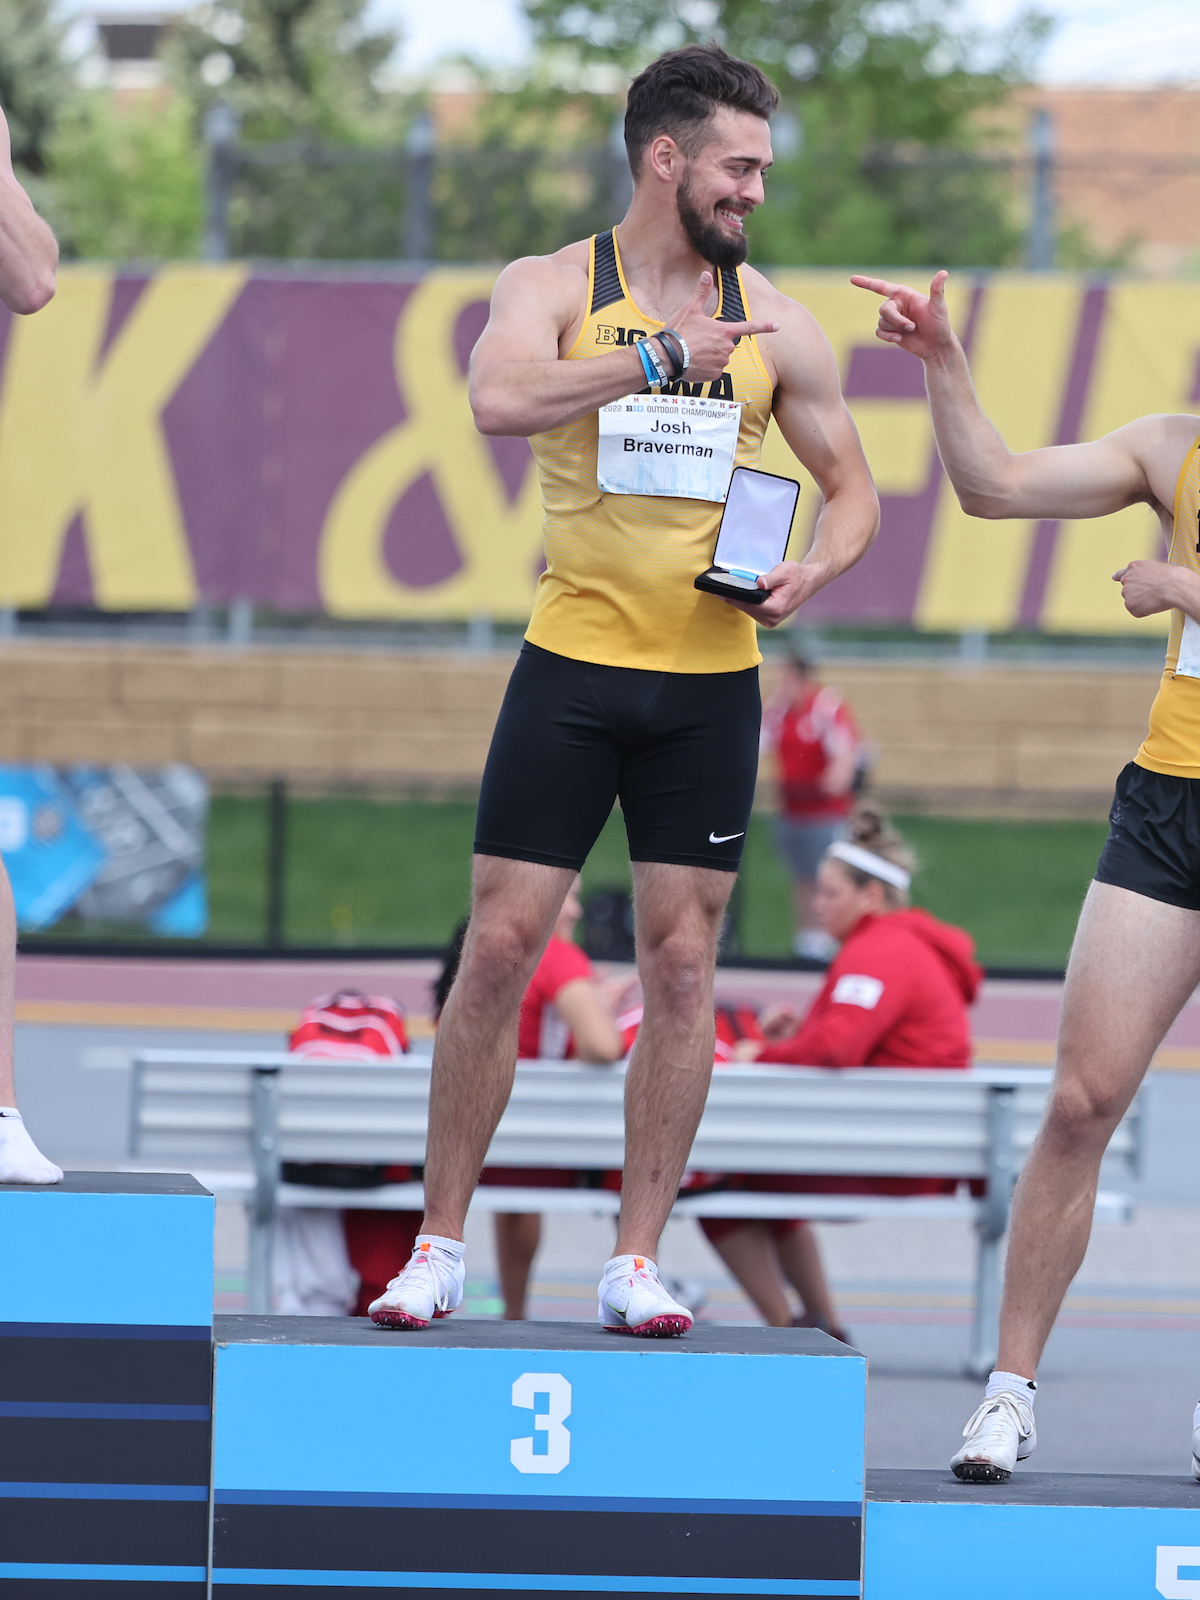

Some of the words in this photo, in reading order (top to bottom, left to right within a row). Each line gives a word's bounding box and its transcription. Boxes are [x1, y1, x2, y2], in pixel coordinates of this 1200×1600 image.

[603, 404, 622, 413] 2022
[647, 405, 679, 415] OUTDOOR
[681, 407, 737, 421] CHAMPIONSHIPS
[650, 420, 692, 435] Josh
[0, 262, 250, 612] K
[317, 265, 536, 622] &
[623, 438, 713, 459] Braverman
[510, 1372, 572, 1475] 3
